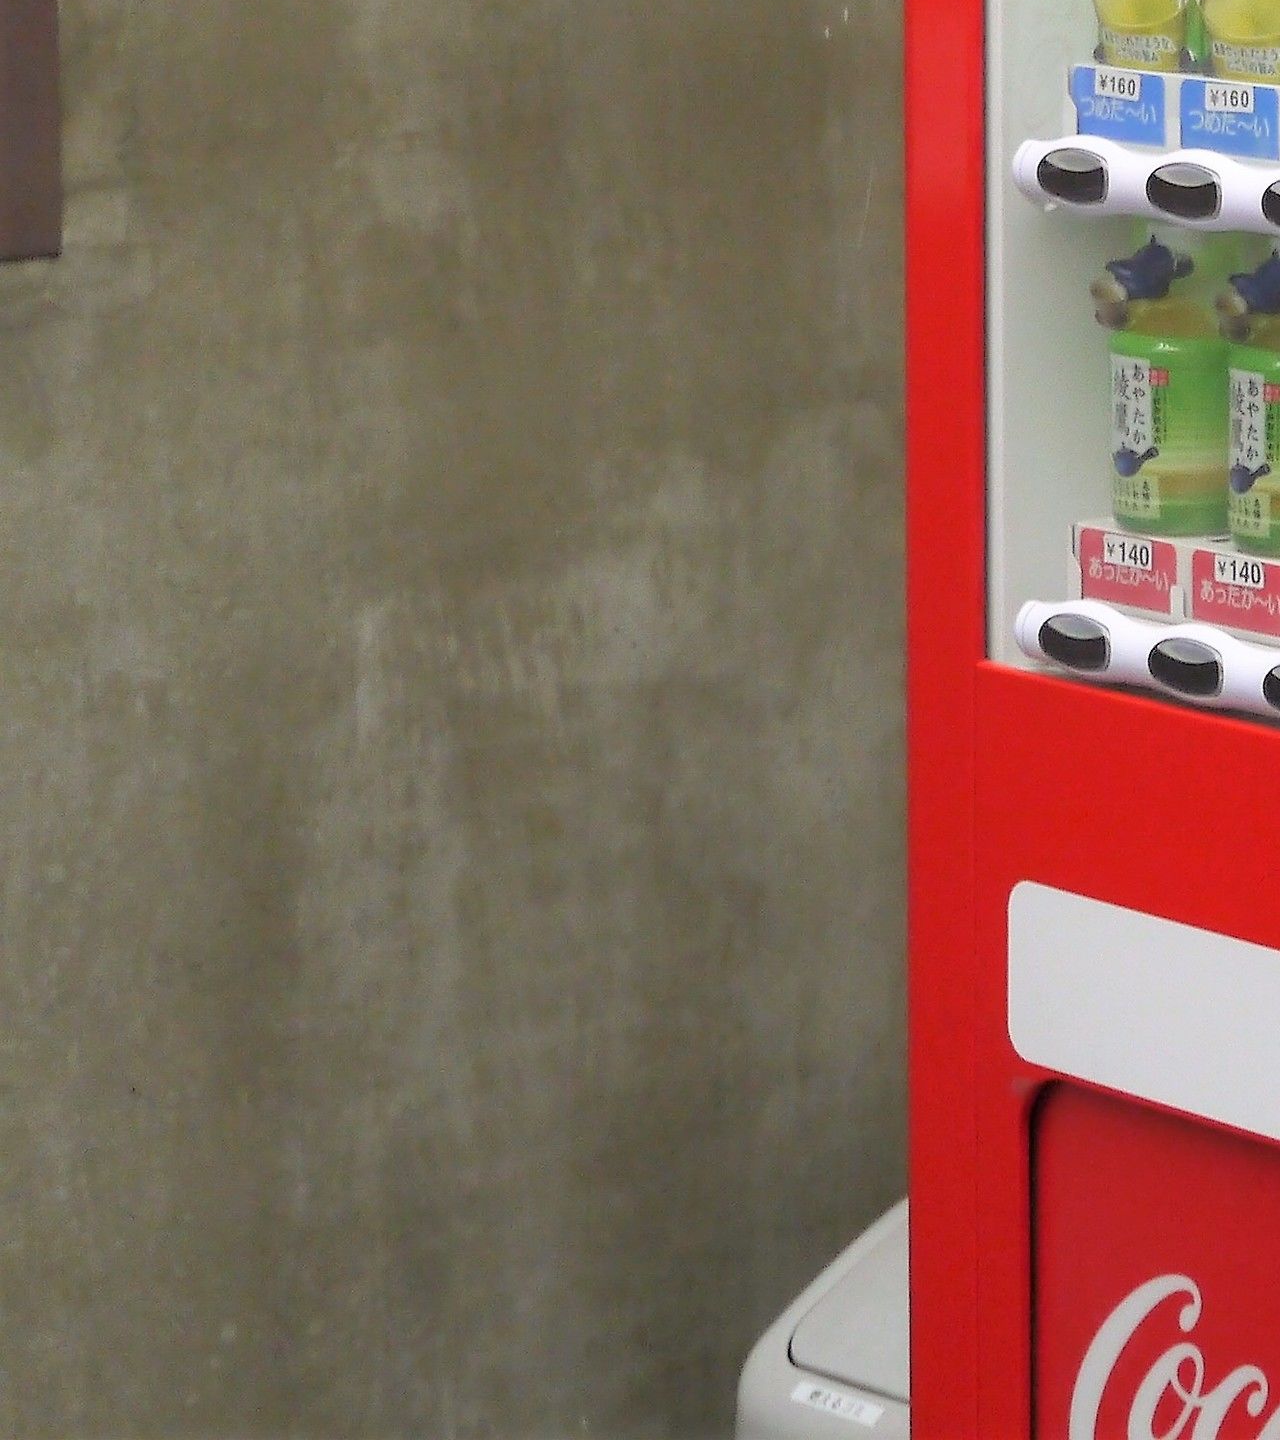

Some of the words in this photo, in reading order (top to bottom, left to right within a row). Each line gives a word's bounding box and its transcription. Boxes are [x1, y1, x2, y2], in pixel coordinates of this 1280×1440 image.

[1099, 74, 1136, 97] ¥160
[1210, 88, 1250, 109] ¥160
[1107, 541, 1150, 566] ¥140
[1217, 559, 1261, 584] ¥140
